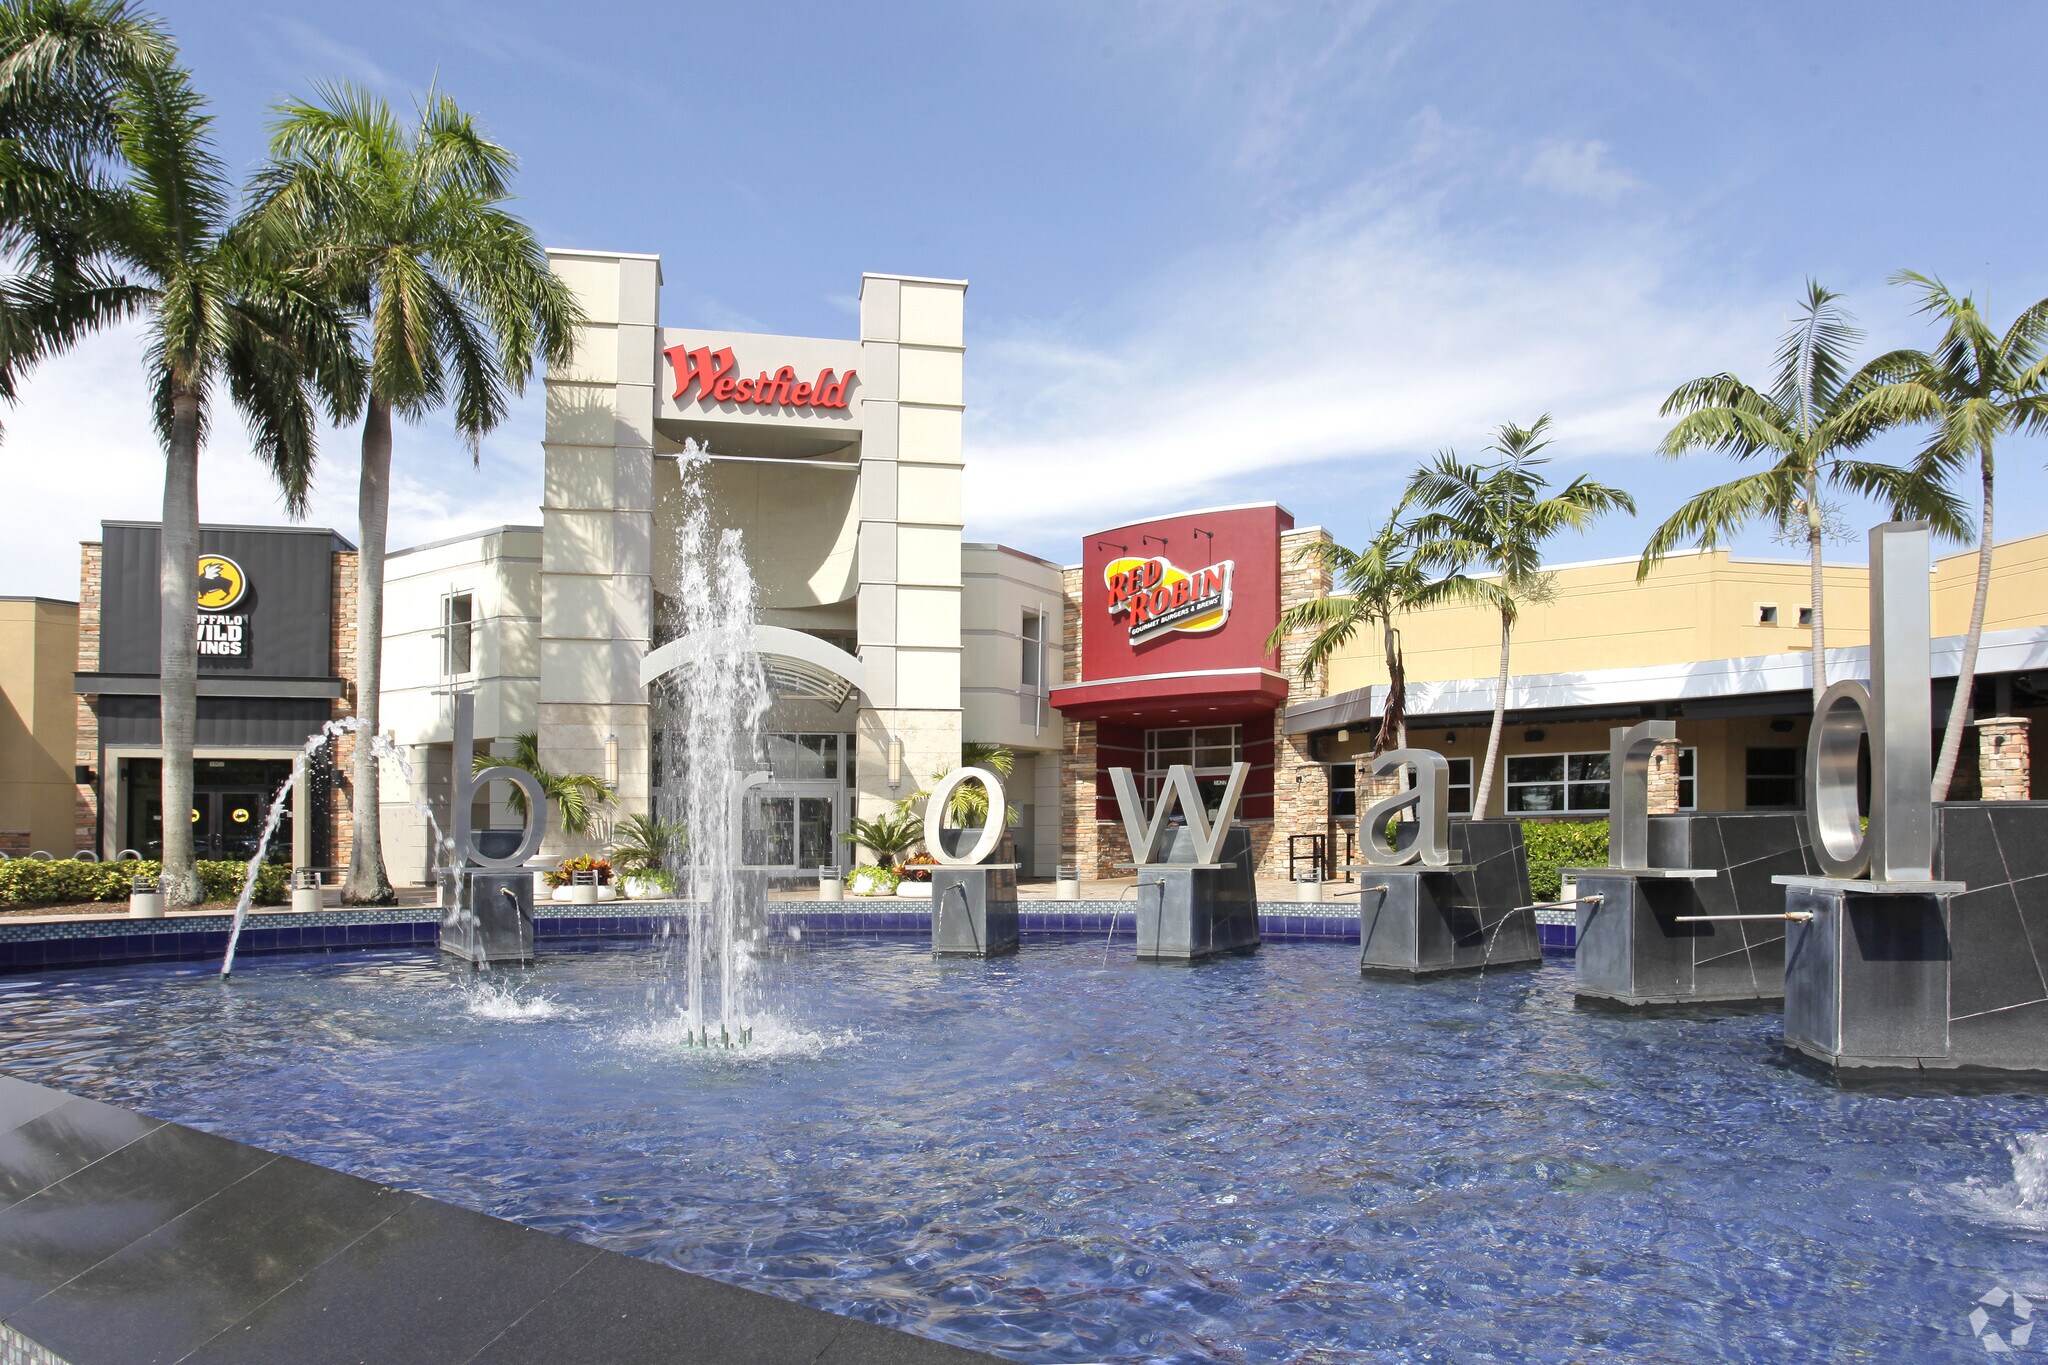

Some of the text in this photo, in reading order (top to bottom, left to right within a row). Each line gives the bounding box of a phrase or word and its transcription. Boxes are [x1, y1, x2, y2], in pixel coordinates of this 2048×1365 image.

[663, 344, 857, 409] Westfield
[1107, 559, 1163, 609] RED
[1129, 563, 1226, 629] ROBIN
[197, 614, 243, 626] FFALO
[1131, 618, 1160, 635] GOURMET
[1160, 607, 1190, 624] BURGERS
[197, 640, 243, 655] INGS
